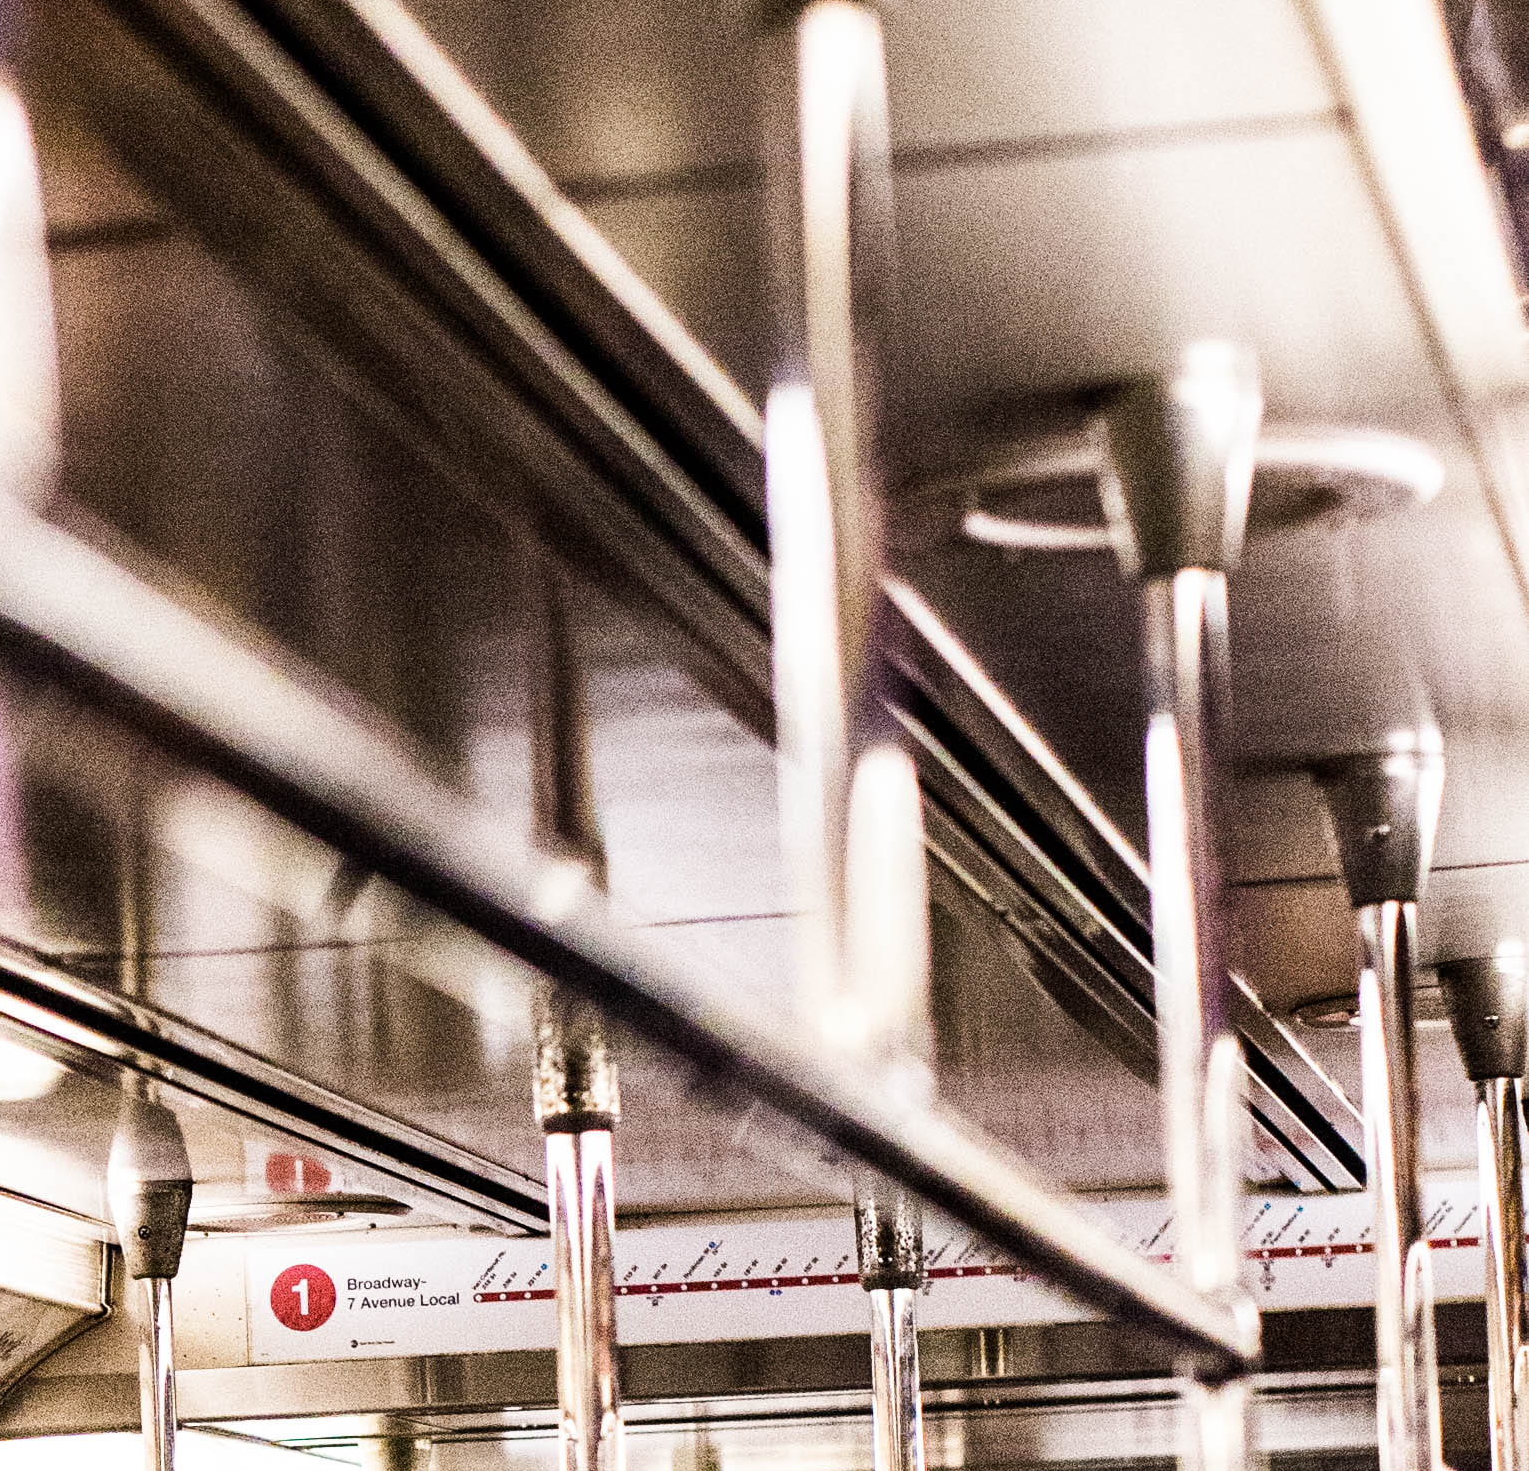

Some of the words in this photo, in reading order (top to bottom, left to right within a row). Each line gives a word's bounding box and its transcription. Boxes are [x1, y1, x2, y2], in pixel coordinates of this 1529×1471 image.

[347, 1277, 427, 1291] Broadway-
[348, 1297, 355, 1310] 7
[361, 1297, 415, 1309] Avenue
[420, 1293, 460, 1307] Local
